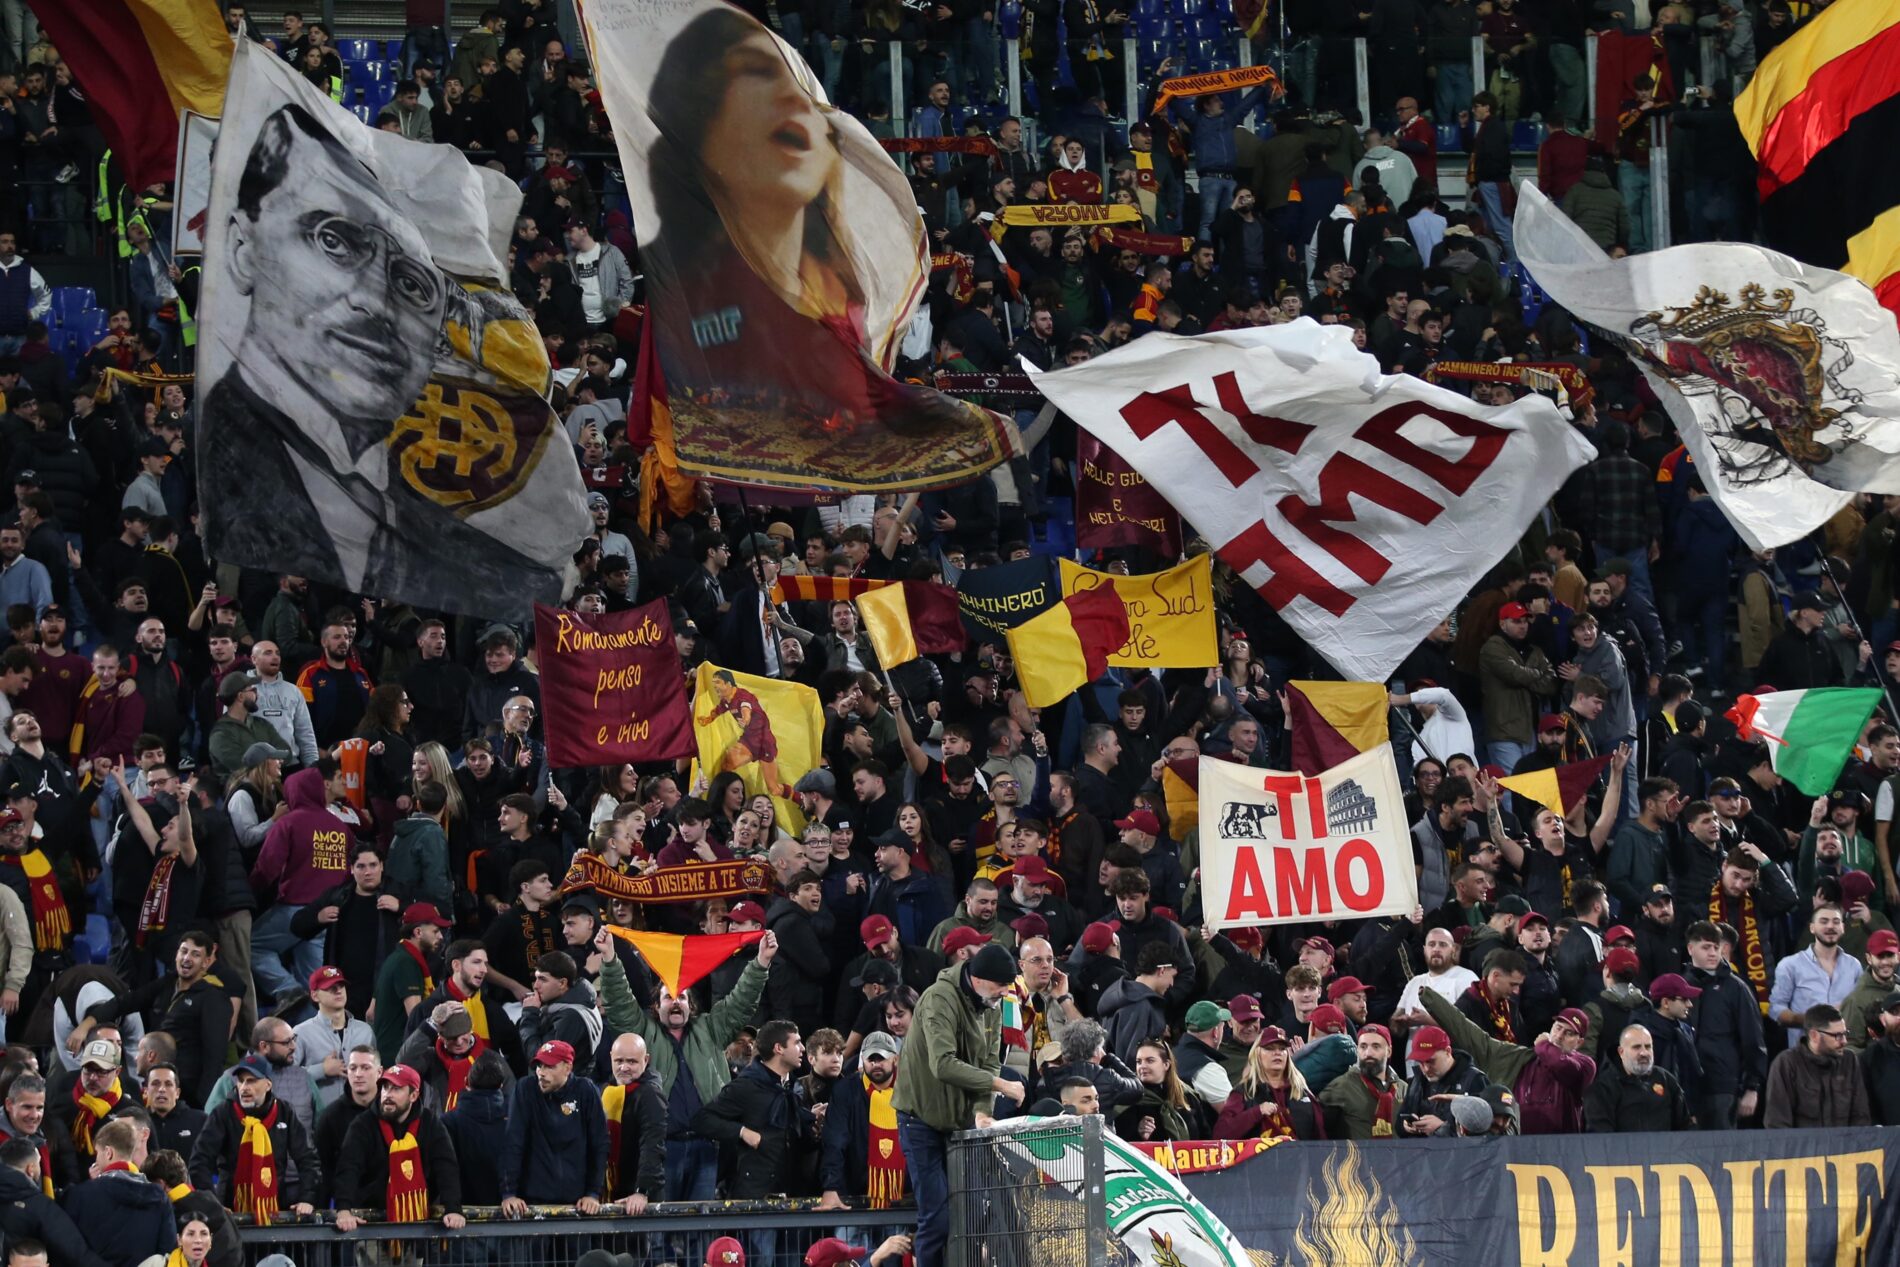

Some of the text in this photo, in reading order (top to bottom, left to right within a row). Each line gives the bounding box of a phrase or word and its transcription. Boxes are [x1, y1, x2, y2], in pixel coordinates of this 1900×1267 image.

[1083, 458, 1144, 487] NELLE GIO
[1089, 512, 1115, 524] NEI
[1112, 499, 1122, 511] E
[1152, 572, 1205, 616] Sud
[557, 613, 662, 653] Romanamente
[594, 664, 642, 709] penso
[597, 711, 649, 745] e vivo
[1264, 775, 1328, 840] TI
[312, 857, 347, 870] STELLE
[1224, 838, 1385, 920] AMO
[656, 871, 706, 894] INSIEME
[709, 872, 718, 889] A
[720, 869, 737, 888] TE
